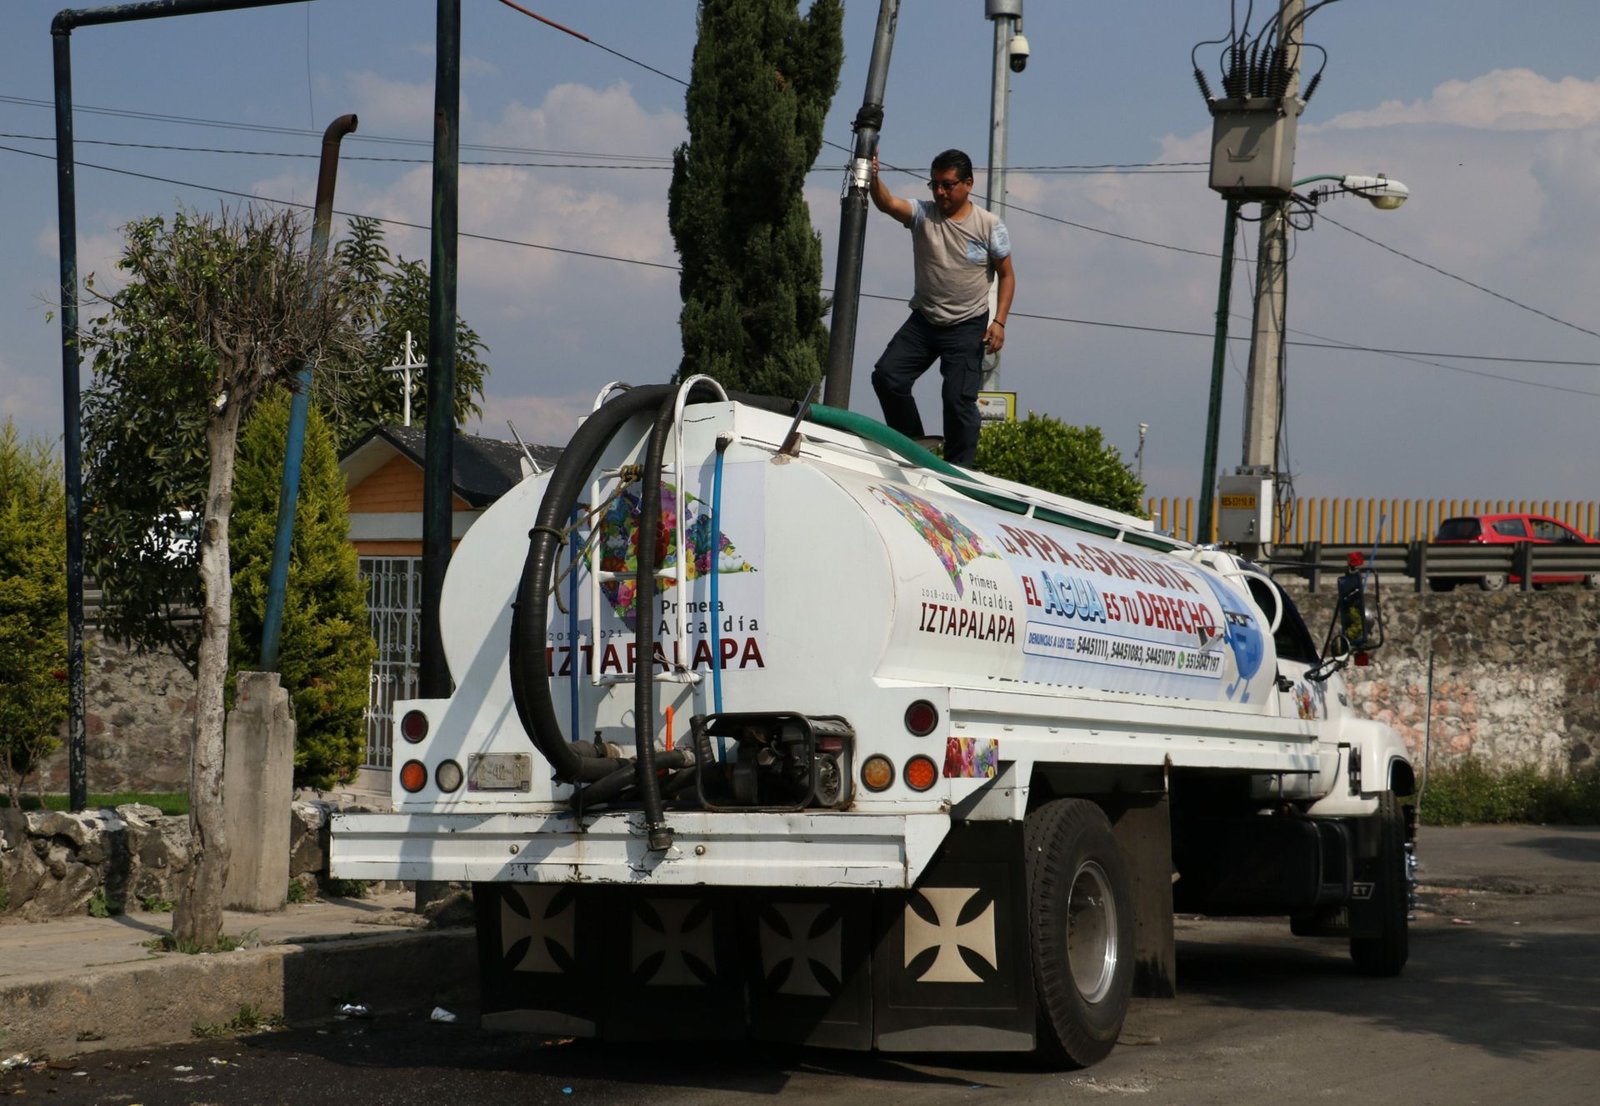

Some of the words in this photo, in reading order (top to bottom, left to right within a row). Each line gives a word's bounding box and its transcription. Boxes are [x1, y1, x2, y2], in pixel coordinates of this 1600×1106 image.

[996, 535, 1021, 556] LA
[998, 523, 1081, 569] PIPA
[1076, 543, 1199, 594] GRATUITA
[969, 573, 998, 591] Primera
[921, 589, 957, 602] 2018-2021
[1021, 575, 1042, 607] EL
[1041, 570, 1107, 625] AGUA
[1103, 592, 1121, 622] ES
[1120, 595, 1140, 625] TU
[1136, 590, 1216, 638] DERECHO
[661, 599, 725, 614] Prmea
[658, 615, 759, 636] Alcadía
[919, 602, 1015, 644] IZTAPALAPA
